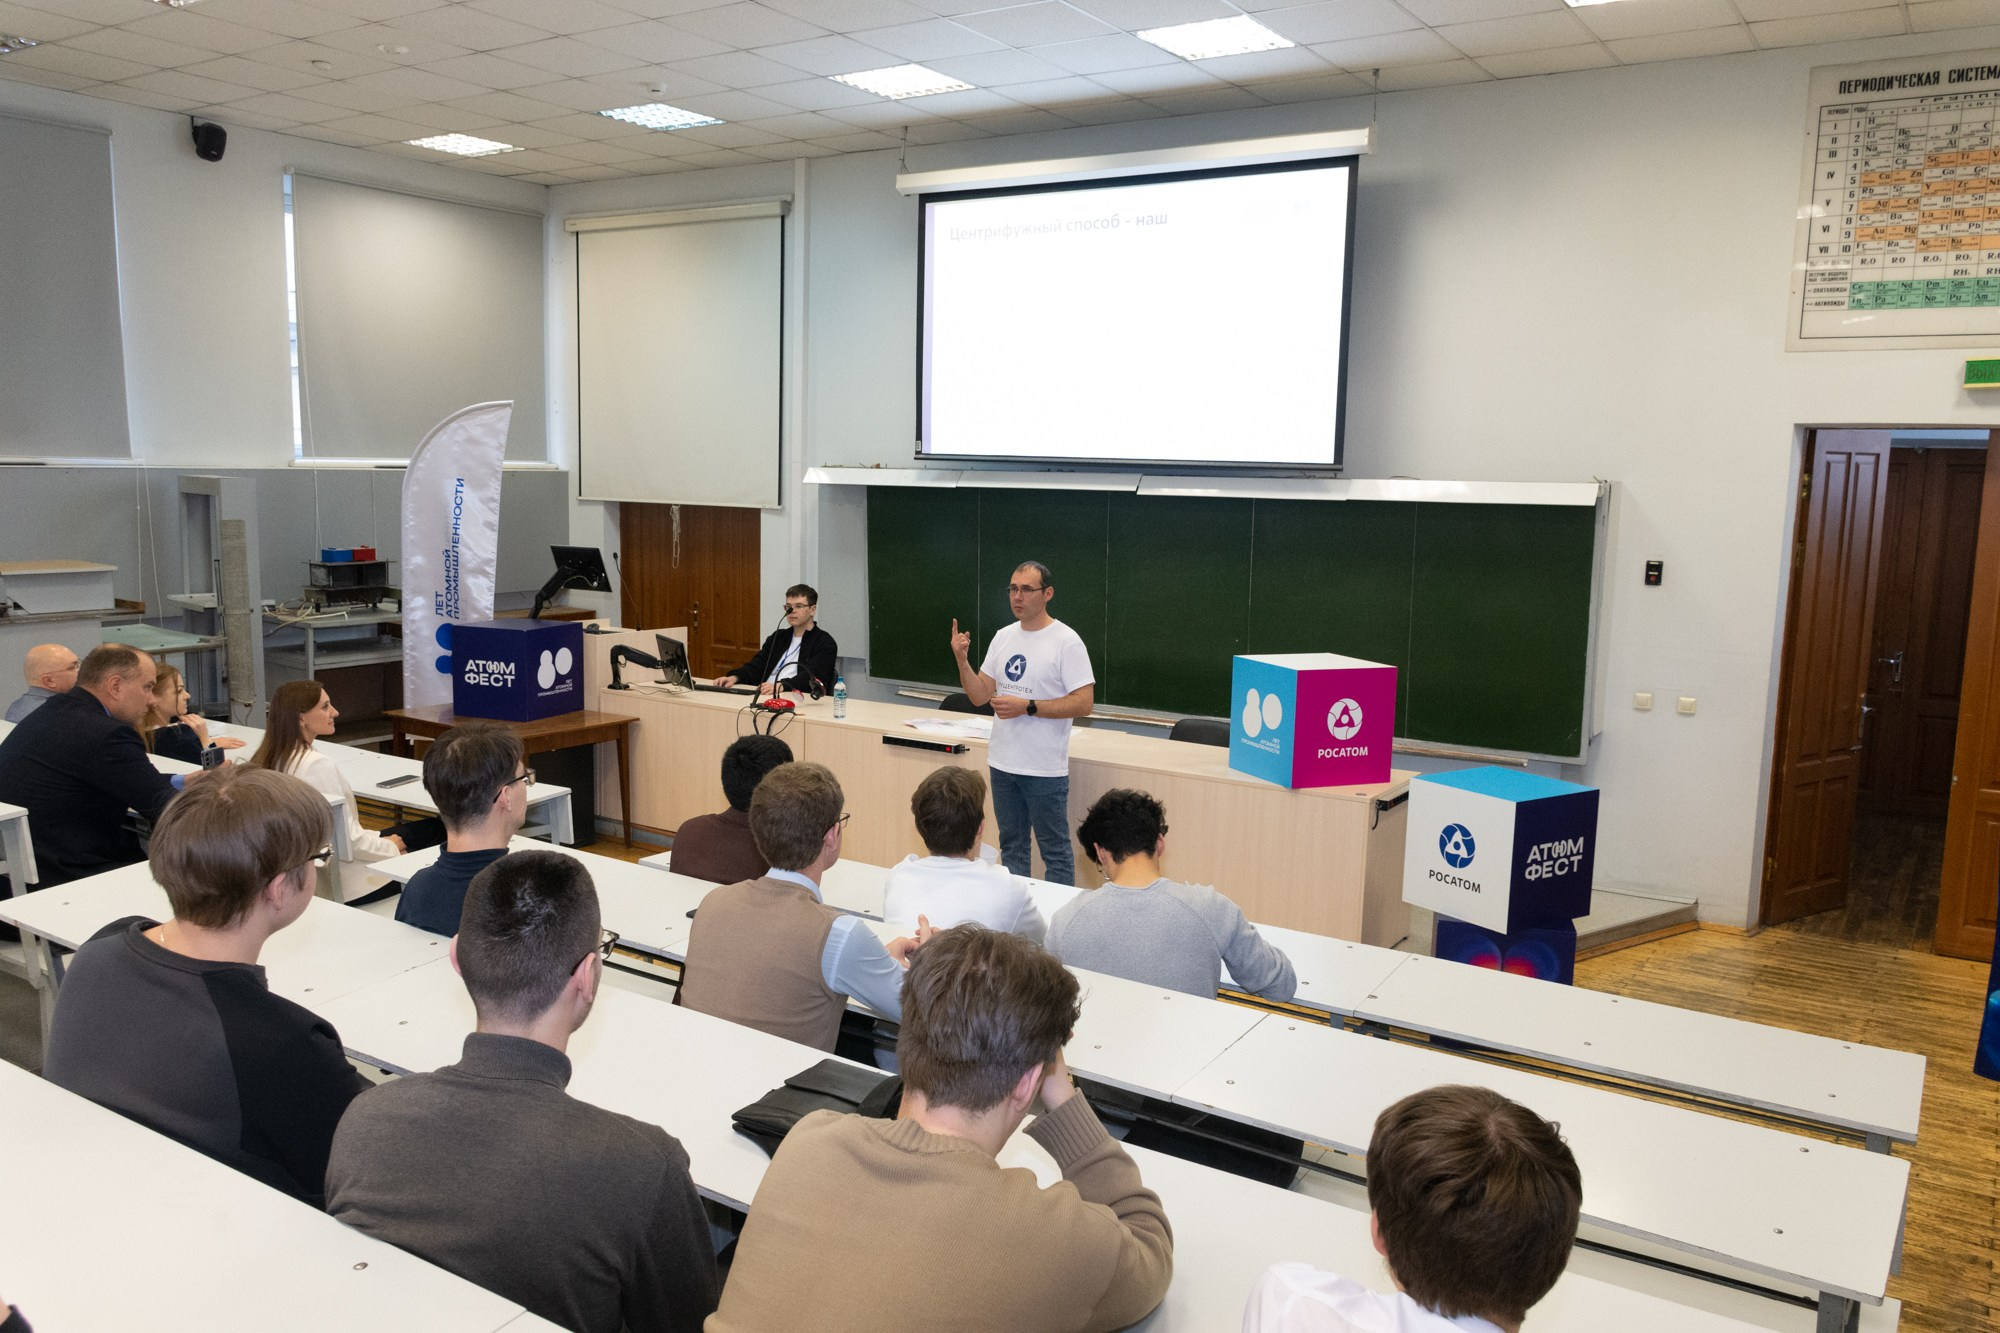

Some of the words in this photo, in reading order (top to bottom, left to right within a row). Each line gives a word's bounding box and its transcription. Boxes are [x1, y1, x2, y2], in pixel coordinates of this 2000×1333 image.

[1839, 71, 1940, 95] ПЕРИОДИЧЕСКАЯ
[1854, 134, 1861, 144] 2
[1852, 148, 1859, 158] 3
[1851, 162, 1858, 171] 4
[1850, 176, 1857, 185] 5
[1848, 190, 1855, 199] 6
[1848, 204, 1854, 213] 7
[950, 219, 1062, 243] Центрифужный
[1065, 212, 1121, 233] способ
[1136, 212, 1168, 228] наш
[1846, 217, 1852, 226] 8
[1844, 230, 1851, 240] 9
[453, 477, 466, 620] ПРОМЫШЛЕННОСТИ
[442, 549, 455, 619] АТОМНОЙ
[435, 590, 445, 617] ЛЕТ
[464, 672, 516, 688] ФЕСТ
[1317, 746, 1368, 759] РОСАТОМ
[1525, 855, 1583, 882] ФЕСТ
[1429, 869, 1481, 894] РОСАТОМ
